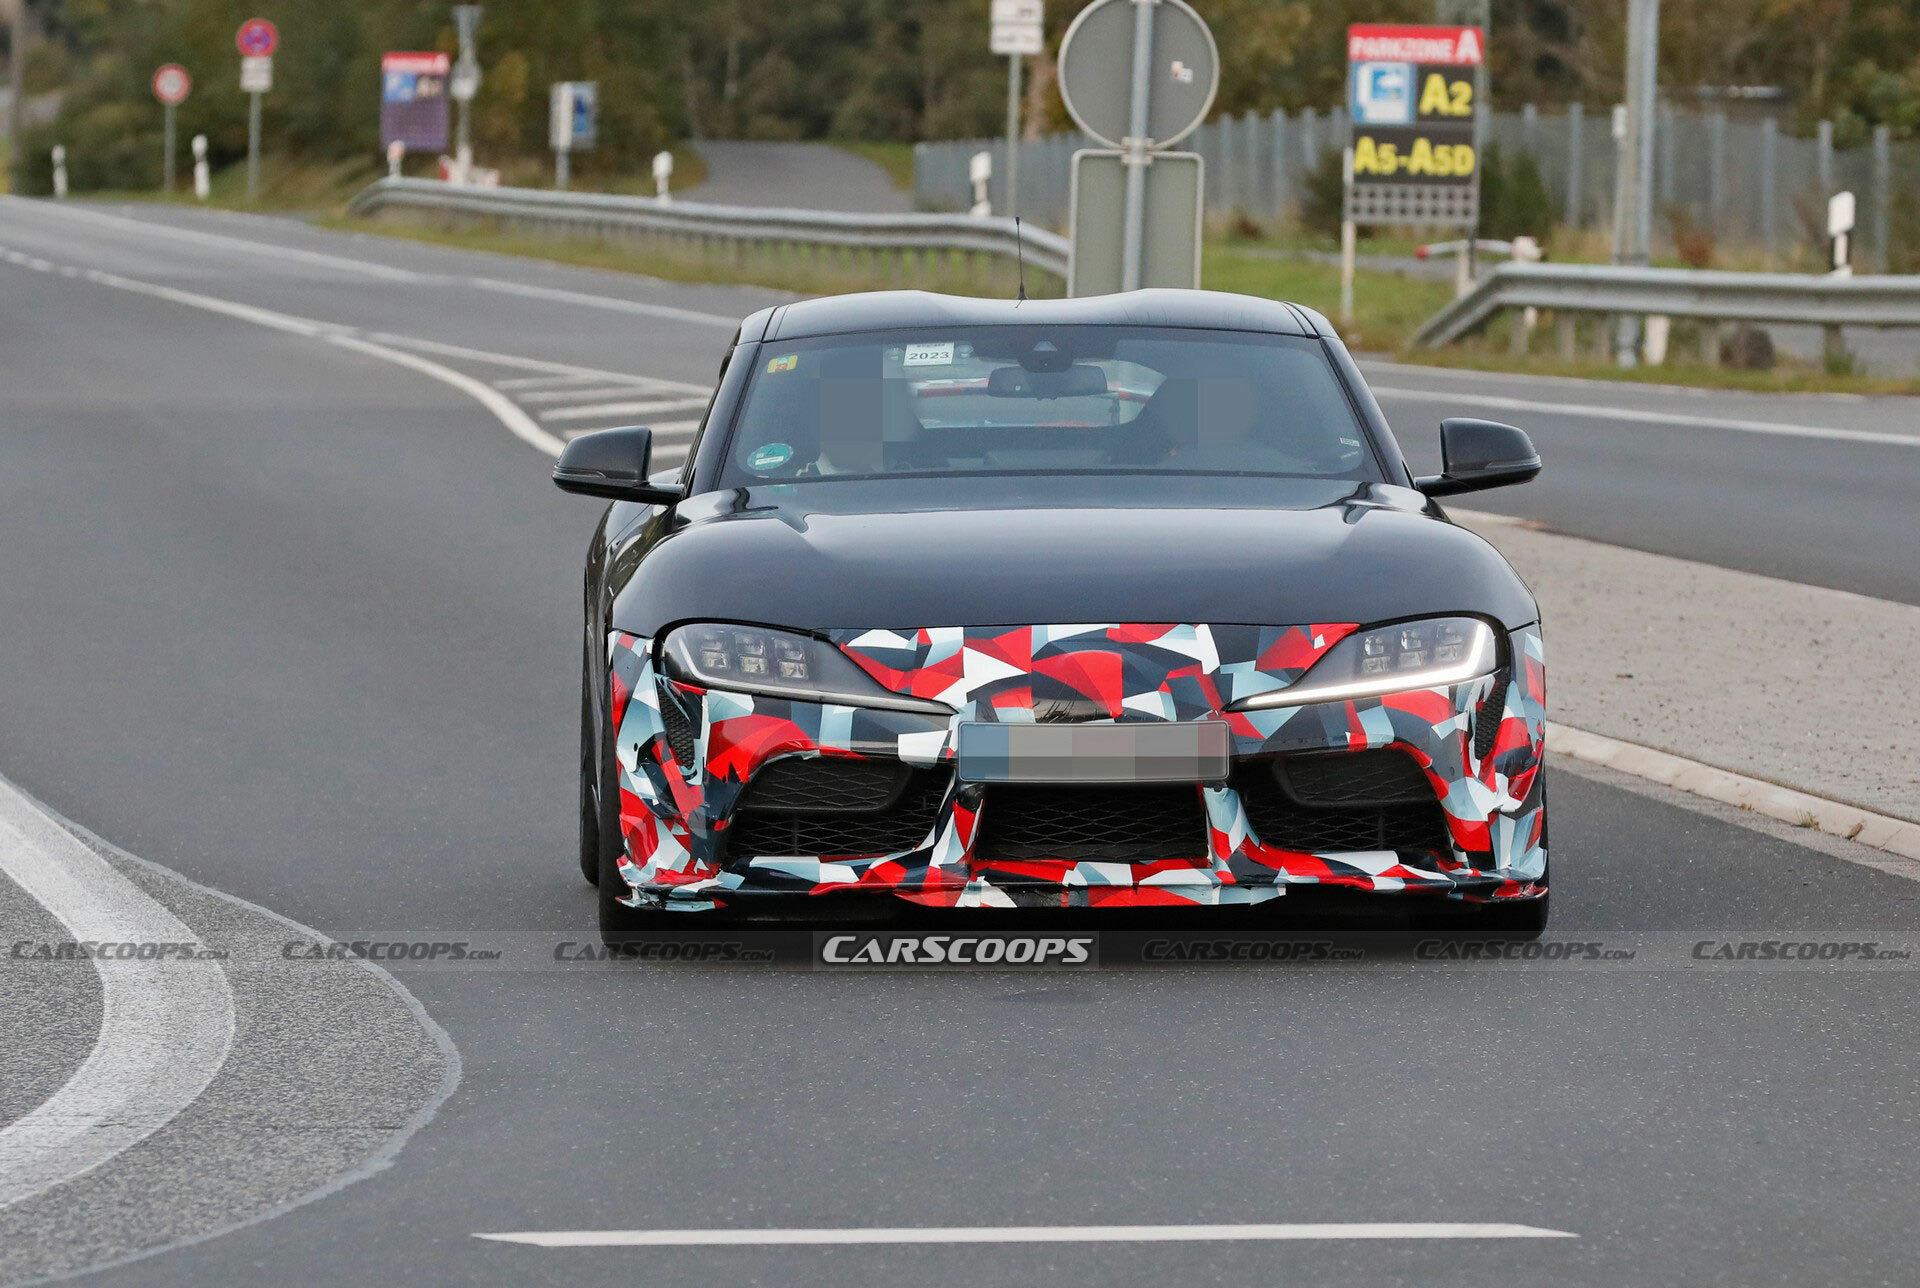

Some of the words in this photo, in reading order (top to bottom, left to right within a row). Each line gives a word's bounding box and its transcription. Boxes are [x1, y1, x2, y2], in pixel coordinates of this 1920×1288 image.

[1456, 29, 1481, 62] A
[1419, 73, 1473, 116] A2
[908, 352, 950, 360] 2023
